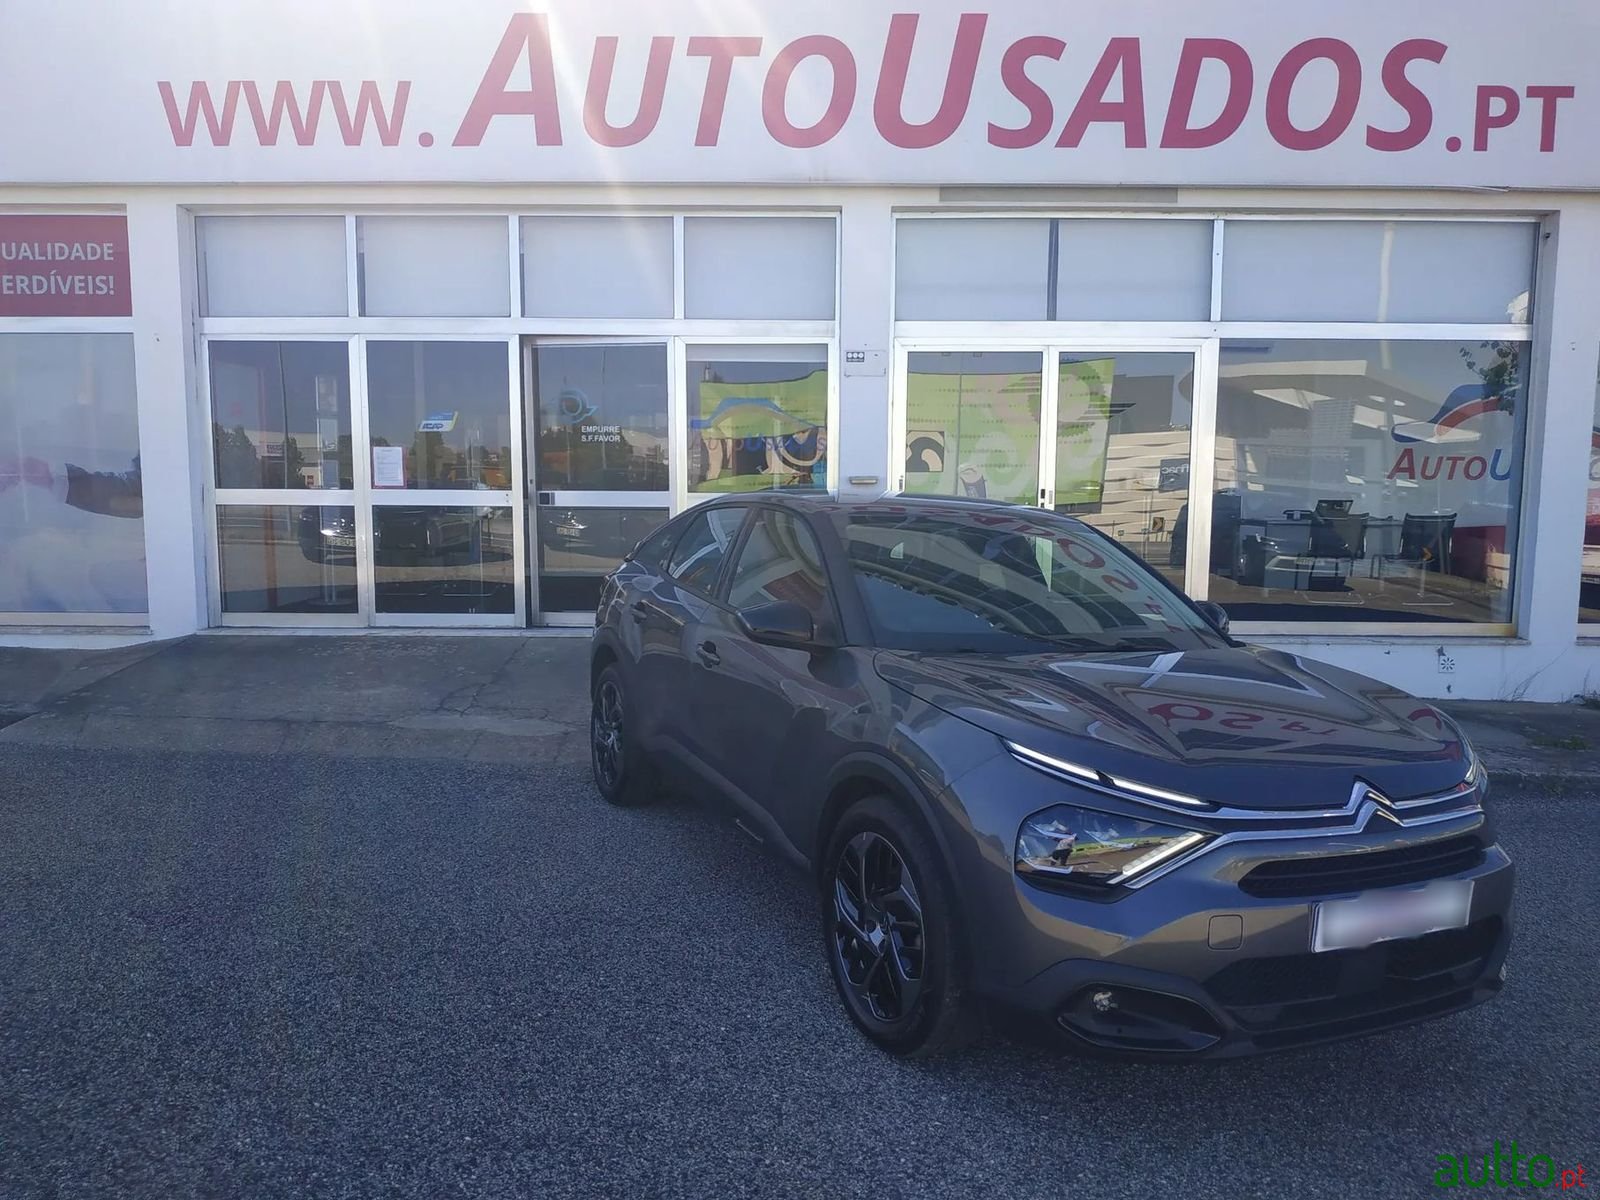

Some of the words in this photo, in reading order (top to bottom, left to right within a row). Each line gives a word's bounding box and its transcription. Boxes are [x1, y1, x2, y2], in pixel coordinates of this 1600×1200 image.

[1, 242, 114, 260] UALIDADE
[2, 269, 115, 295] ERDÍVEIS!
[581, 425, 621, 433] EMPURRE
